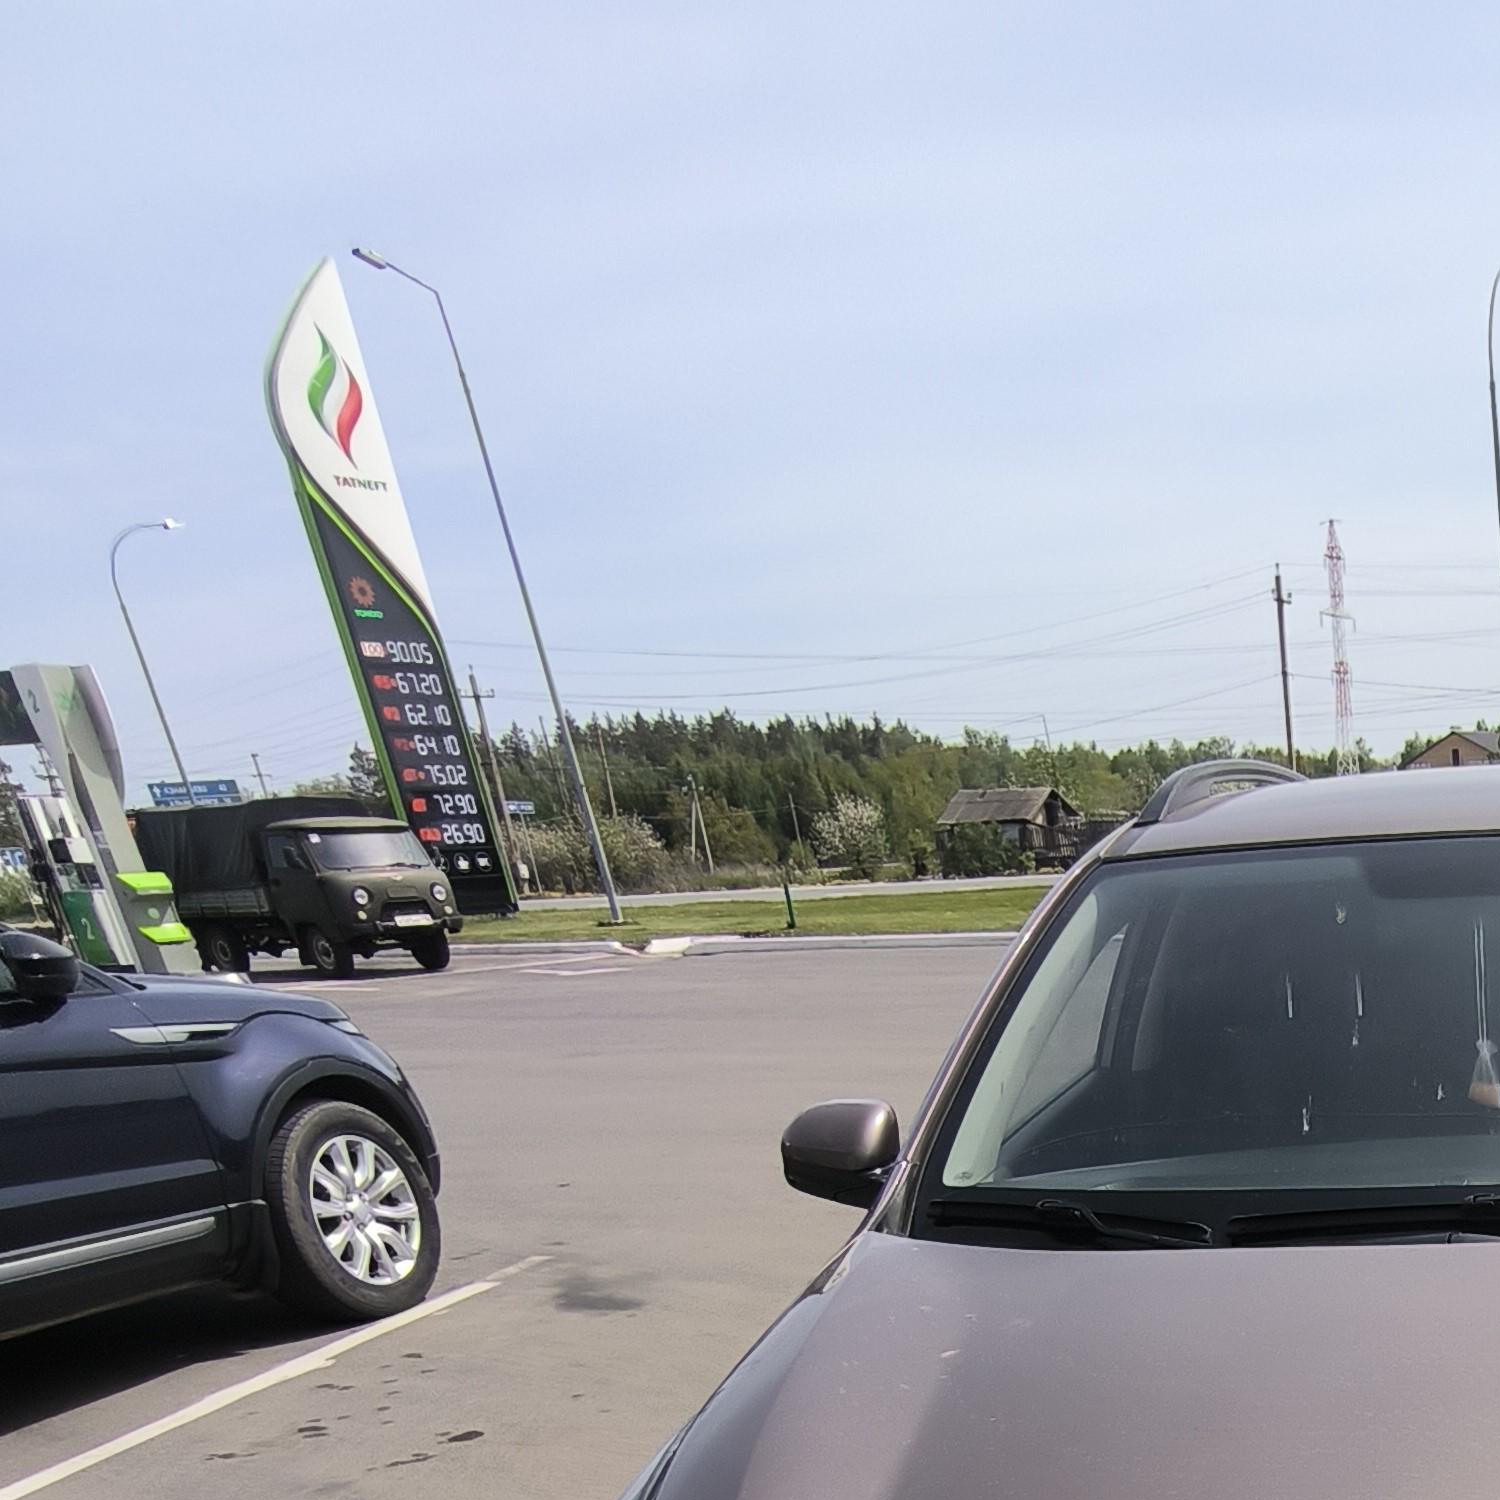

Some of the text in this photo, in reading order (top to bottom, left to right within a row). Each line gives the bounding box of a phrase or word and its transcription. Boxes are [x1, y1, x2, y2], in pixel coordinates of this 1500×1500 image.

[333, 475, 387, 492] TATNEFT
[27, 689, 40, 713] 2
[404, 704, 452, 726] 62.10
[81, 918, 95, 940] 2
